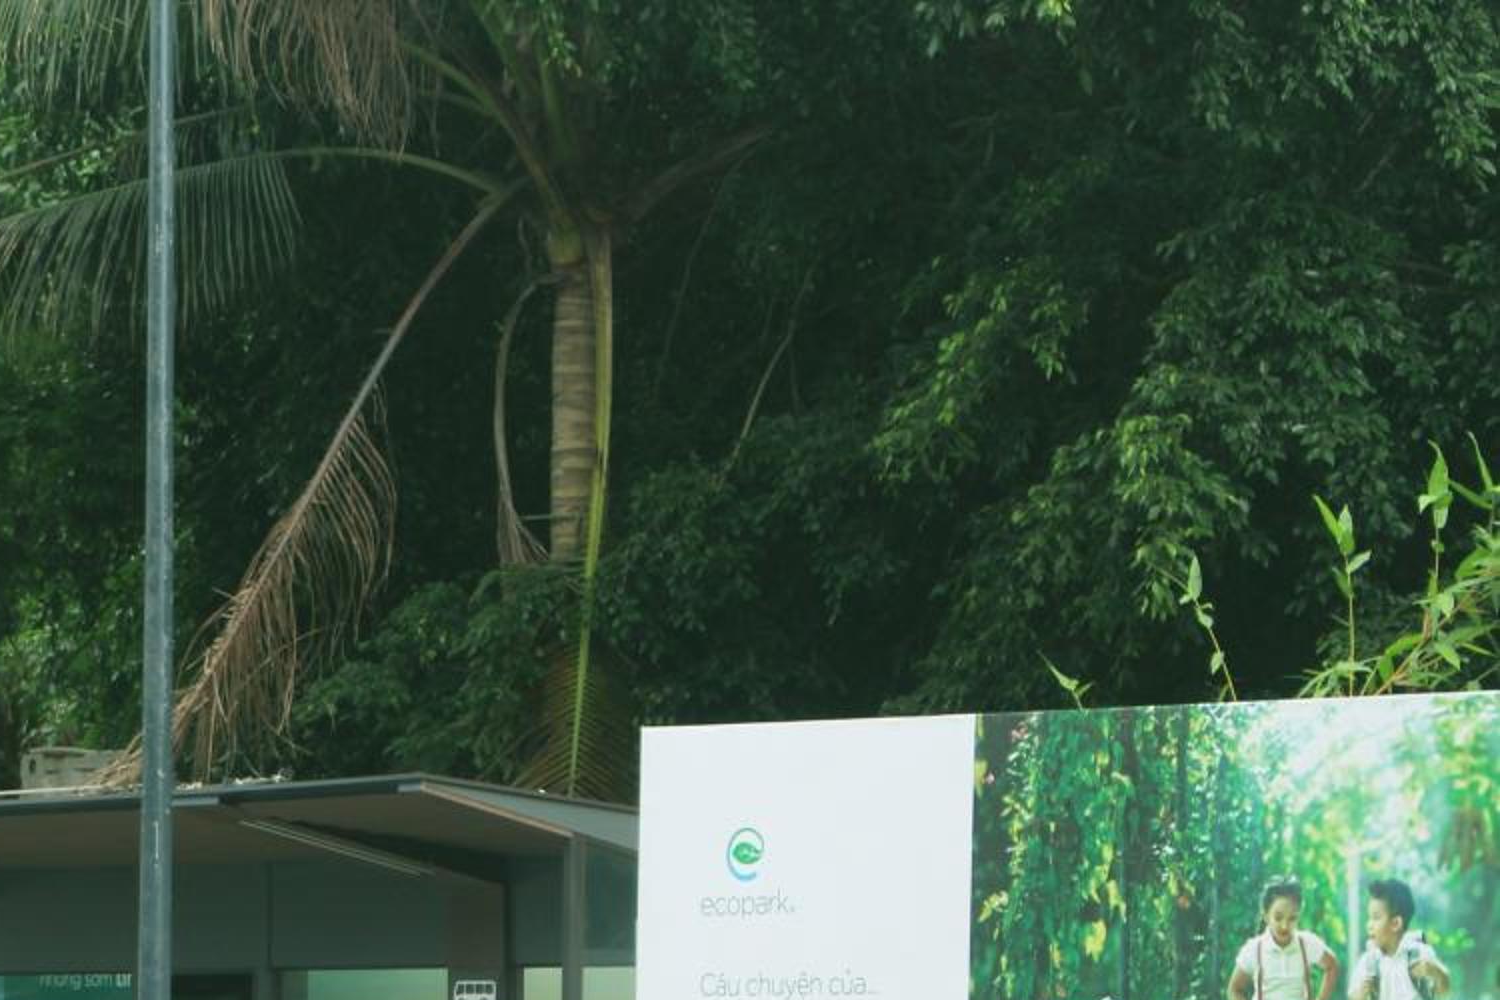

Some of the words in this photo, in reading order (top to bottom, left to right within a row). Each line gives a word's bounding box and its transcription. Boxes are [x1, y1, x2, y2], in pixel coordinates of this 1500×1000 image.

[699, 886, 795, 918] ecopark.
[699, 972, 741, 998] Câu
[745, 971, 822, 1000] chuyện
